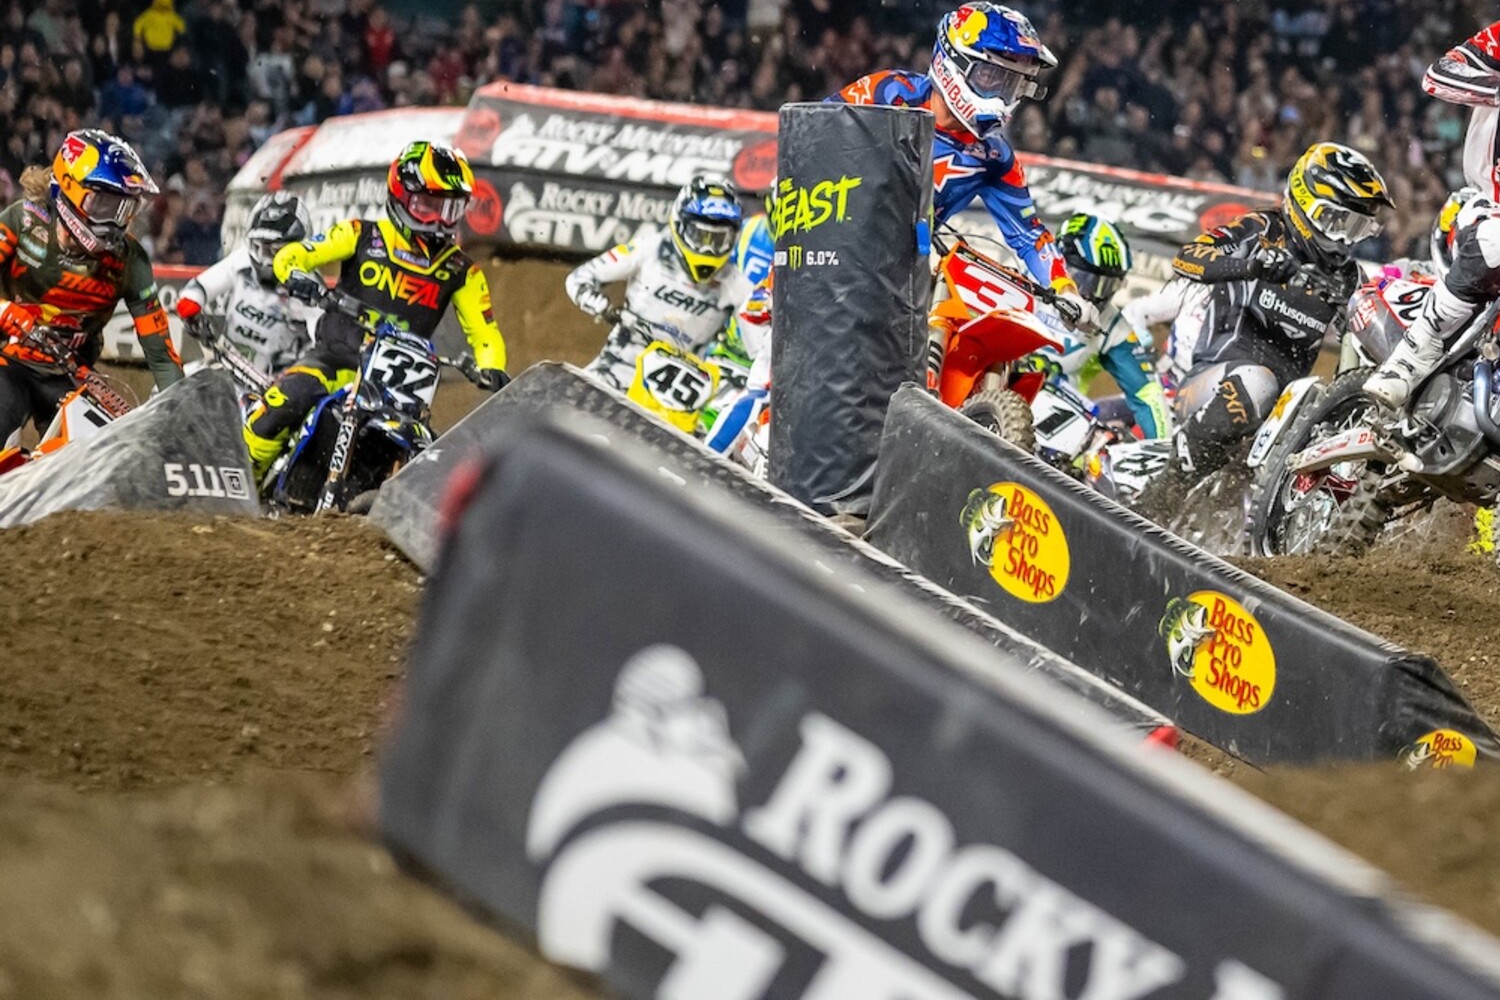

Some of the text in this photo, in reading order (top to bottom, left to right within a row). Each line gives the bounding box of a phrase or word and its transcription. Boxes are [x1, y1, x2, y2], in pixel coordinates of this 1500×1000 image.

[539, 182, 616, 217] ROCKY
[805, 250, 840, 266] 6.0%
[954, 263, 1035, 316] 3
[370, 348, 437, 403] 32
[647, 362, 705, 409] 45
[164, 463, 226, 498] 5.11
[1008, 488, 1051, 536] Bass
[1007, 518, 1040, 559] Pro
[1003, 546, 1056, 599] Shops
[1209, 597, 1255, 646] Bass
[1208, 629, 1243, 670] Pro
[1205, 658, 1261, 712] Shops
[1431, 732, 1463, 752] Bass
[743, 710, 1187, 1000] ROCKY
